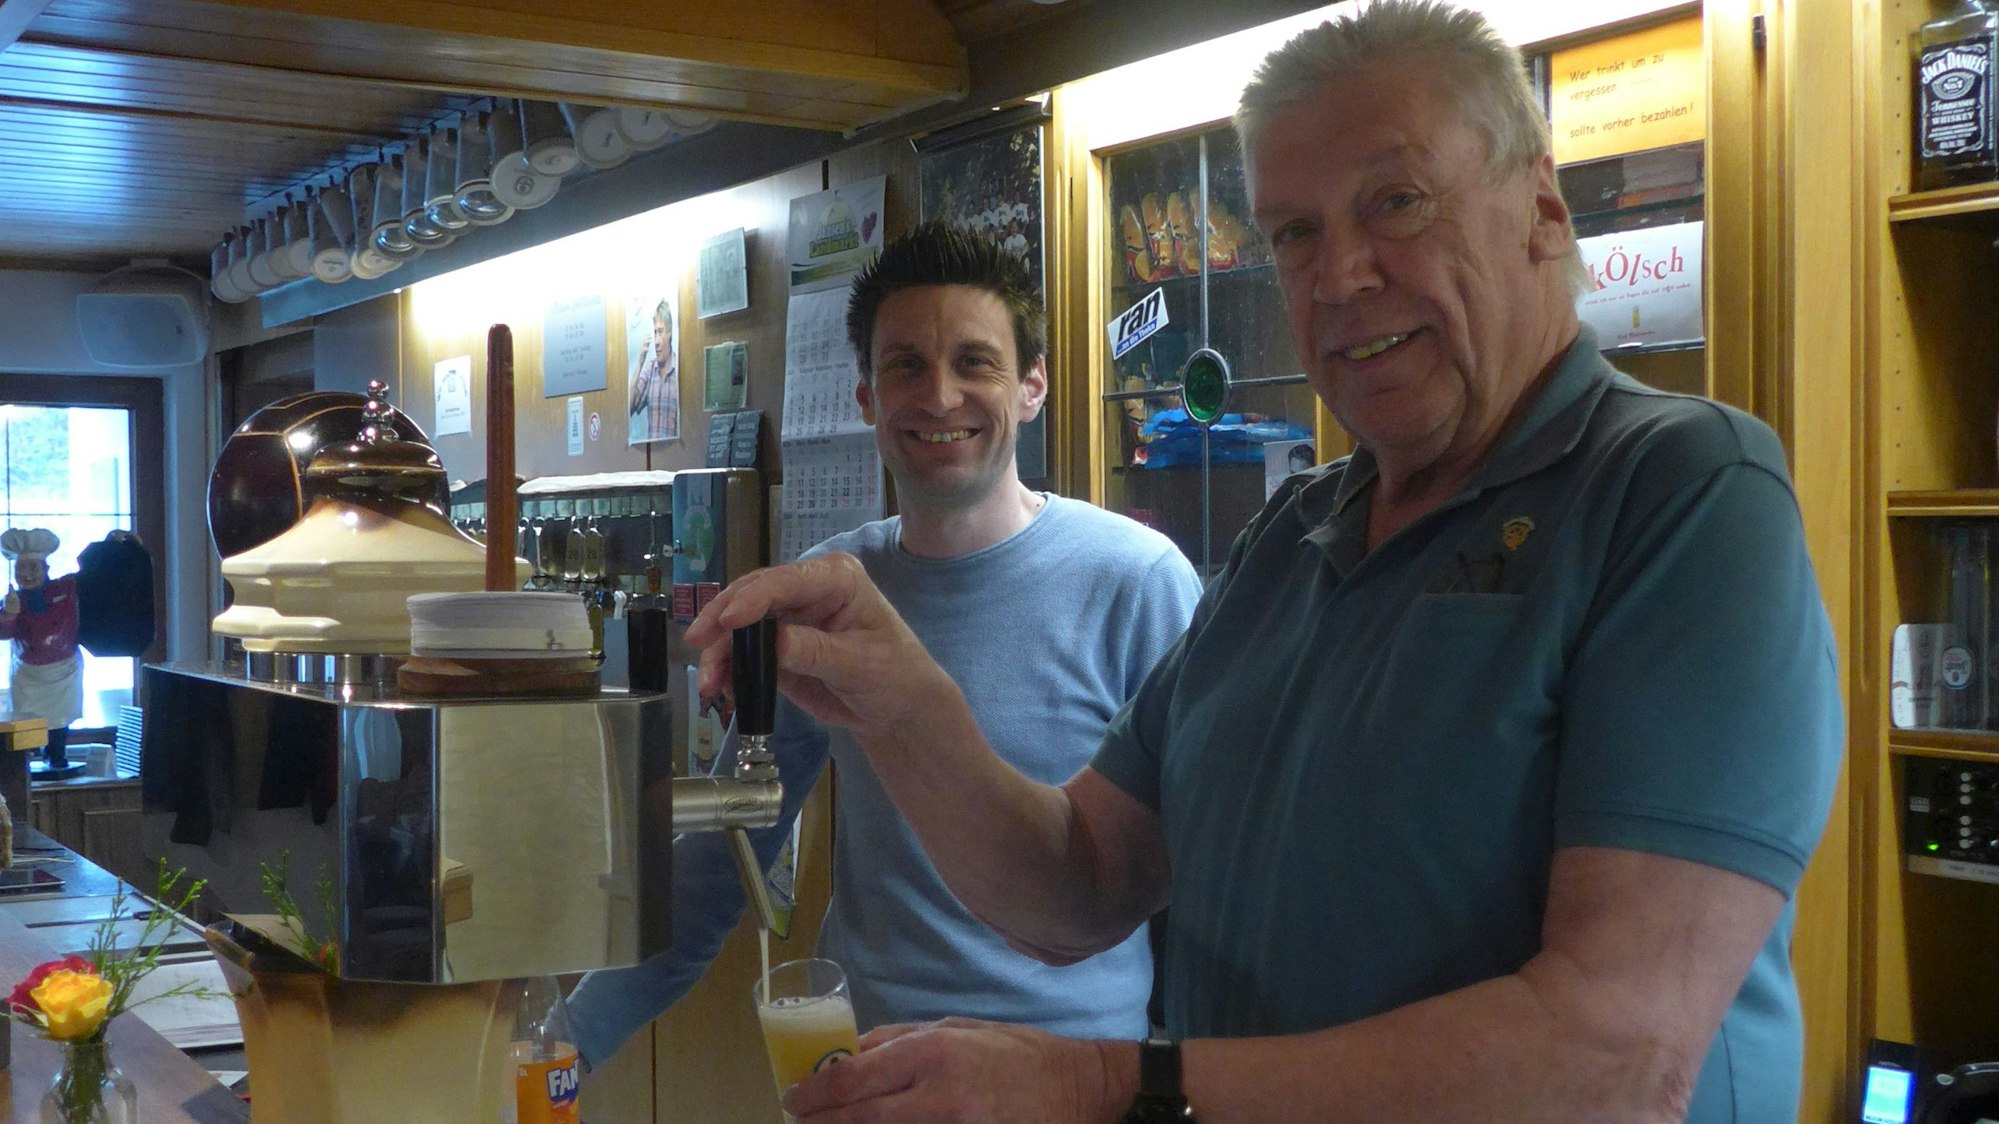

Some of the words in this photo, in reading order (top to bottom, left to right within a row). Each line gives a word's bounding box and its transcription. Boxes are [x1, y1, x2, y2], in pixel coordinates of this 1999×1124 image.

[1570, 70, 1590, 82] Wer
[1597, 61, 1625, 77] trinkt
[1632, 57, 1646, 69] um
[1653, 53, 1664, 64] zu
[1921, 58, 1947, 85] JACK
[1947, 51, 1989, 74] DANIEL'S
[1570, 83, 1617, 101] vergessen
[1570, 126, 1596, 138] sollte
[1602, 116, 1635, 131] vorher
[1641, 106, 1687, 123] bezahlen
[1931, 111, 1974, 125] WHISKEY
[1118, 290, 1160, 342] ran
